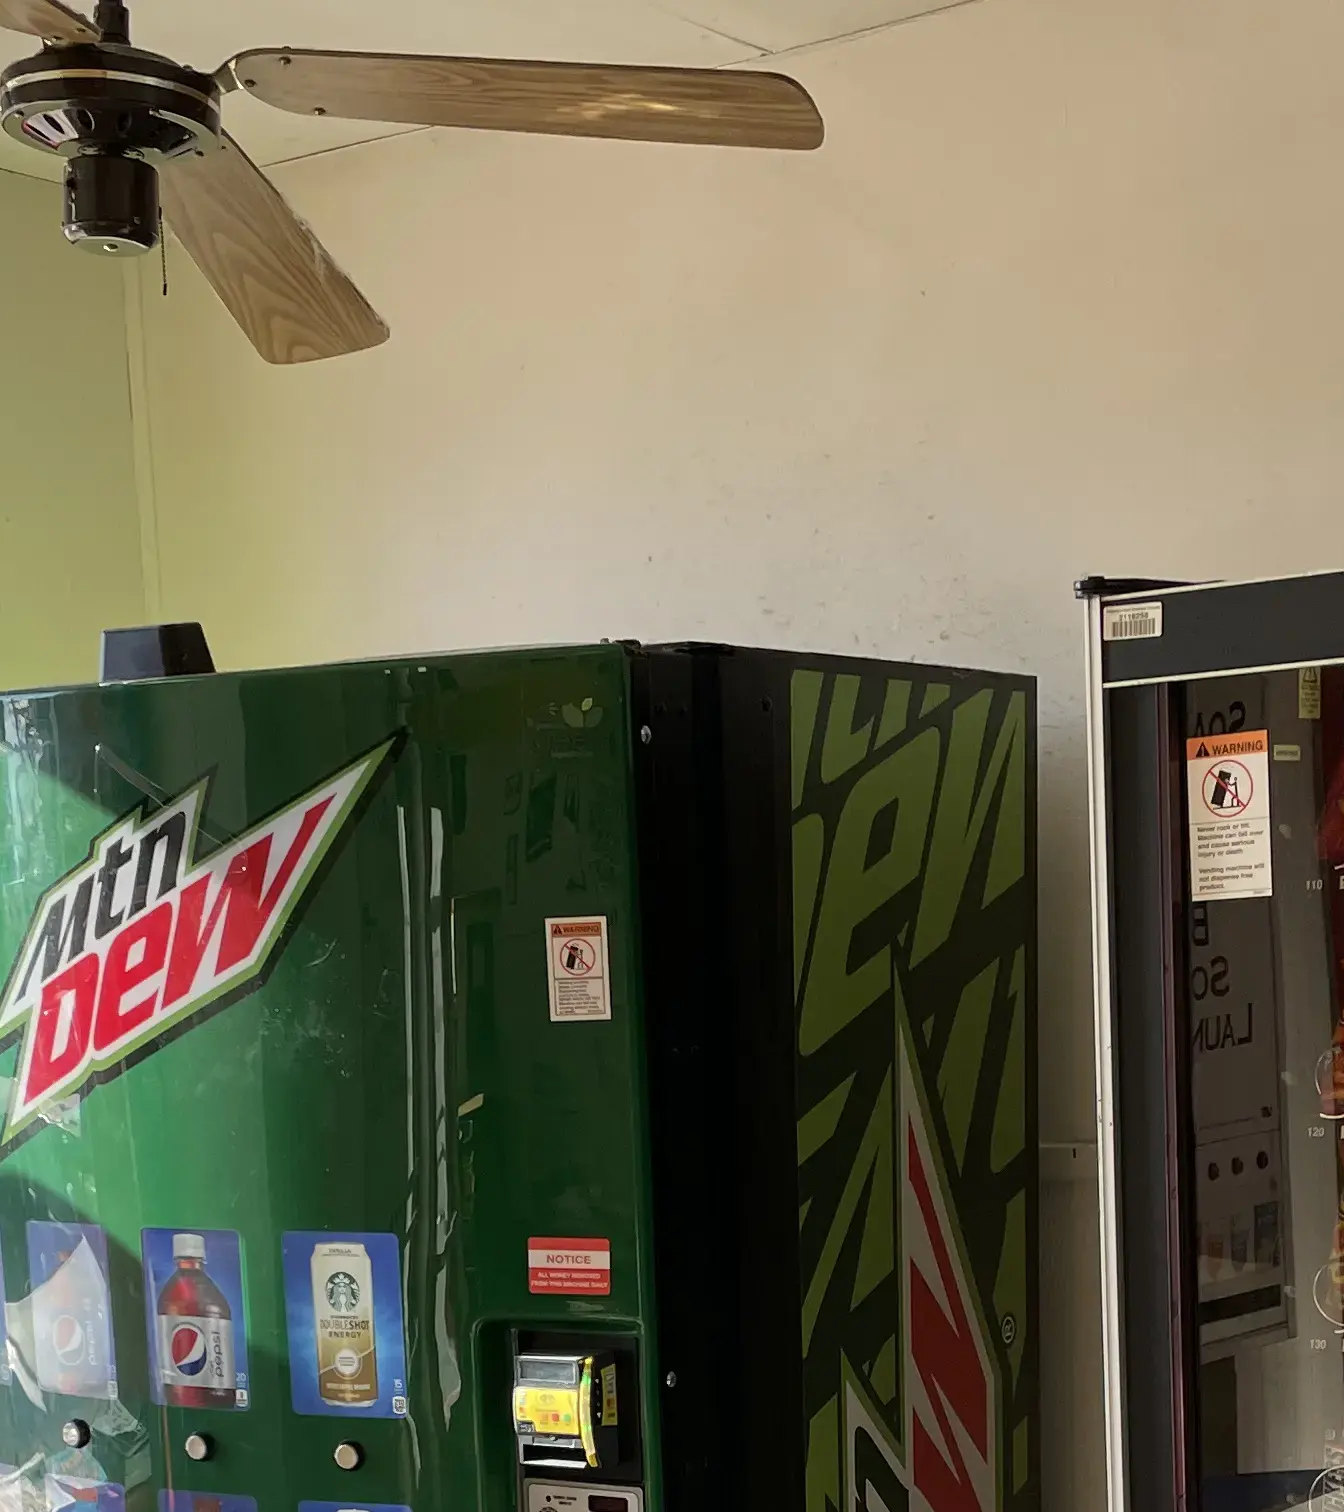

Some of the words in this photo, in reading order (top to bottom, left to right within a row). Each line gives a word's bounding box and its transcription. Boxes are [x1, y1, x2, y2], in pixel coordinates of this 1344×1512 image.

[1212, 740, 1264, 756] WARNING
[1306, 879, 1323, 891] 110
[13, 807, 188, 1005] Mtn
[1307, 1127, 1325, 1138] 120
[546, 1254, 592, 1265] NOTICE
[319, 1319, 370, 1331] DOUBLESHOT
[1309, 1339, 1327, 1350] 130
[211, 1330, 225, 1378] pepsi
